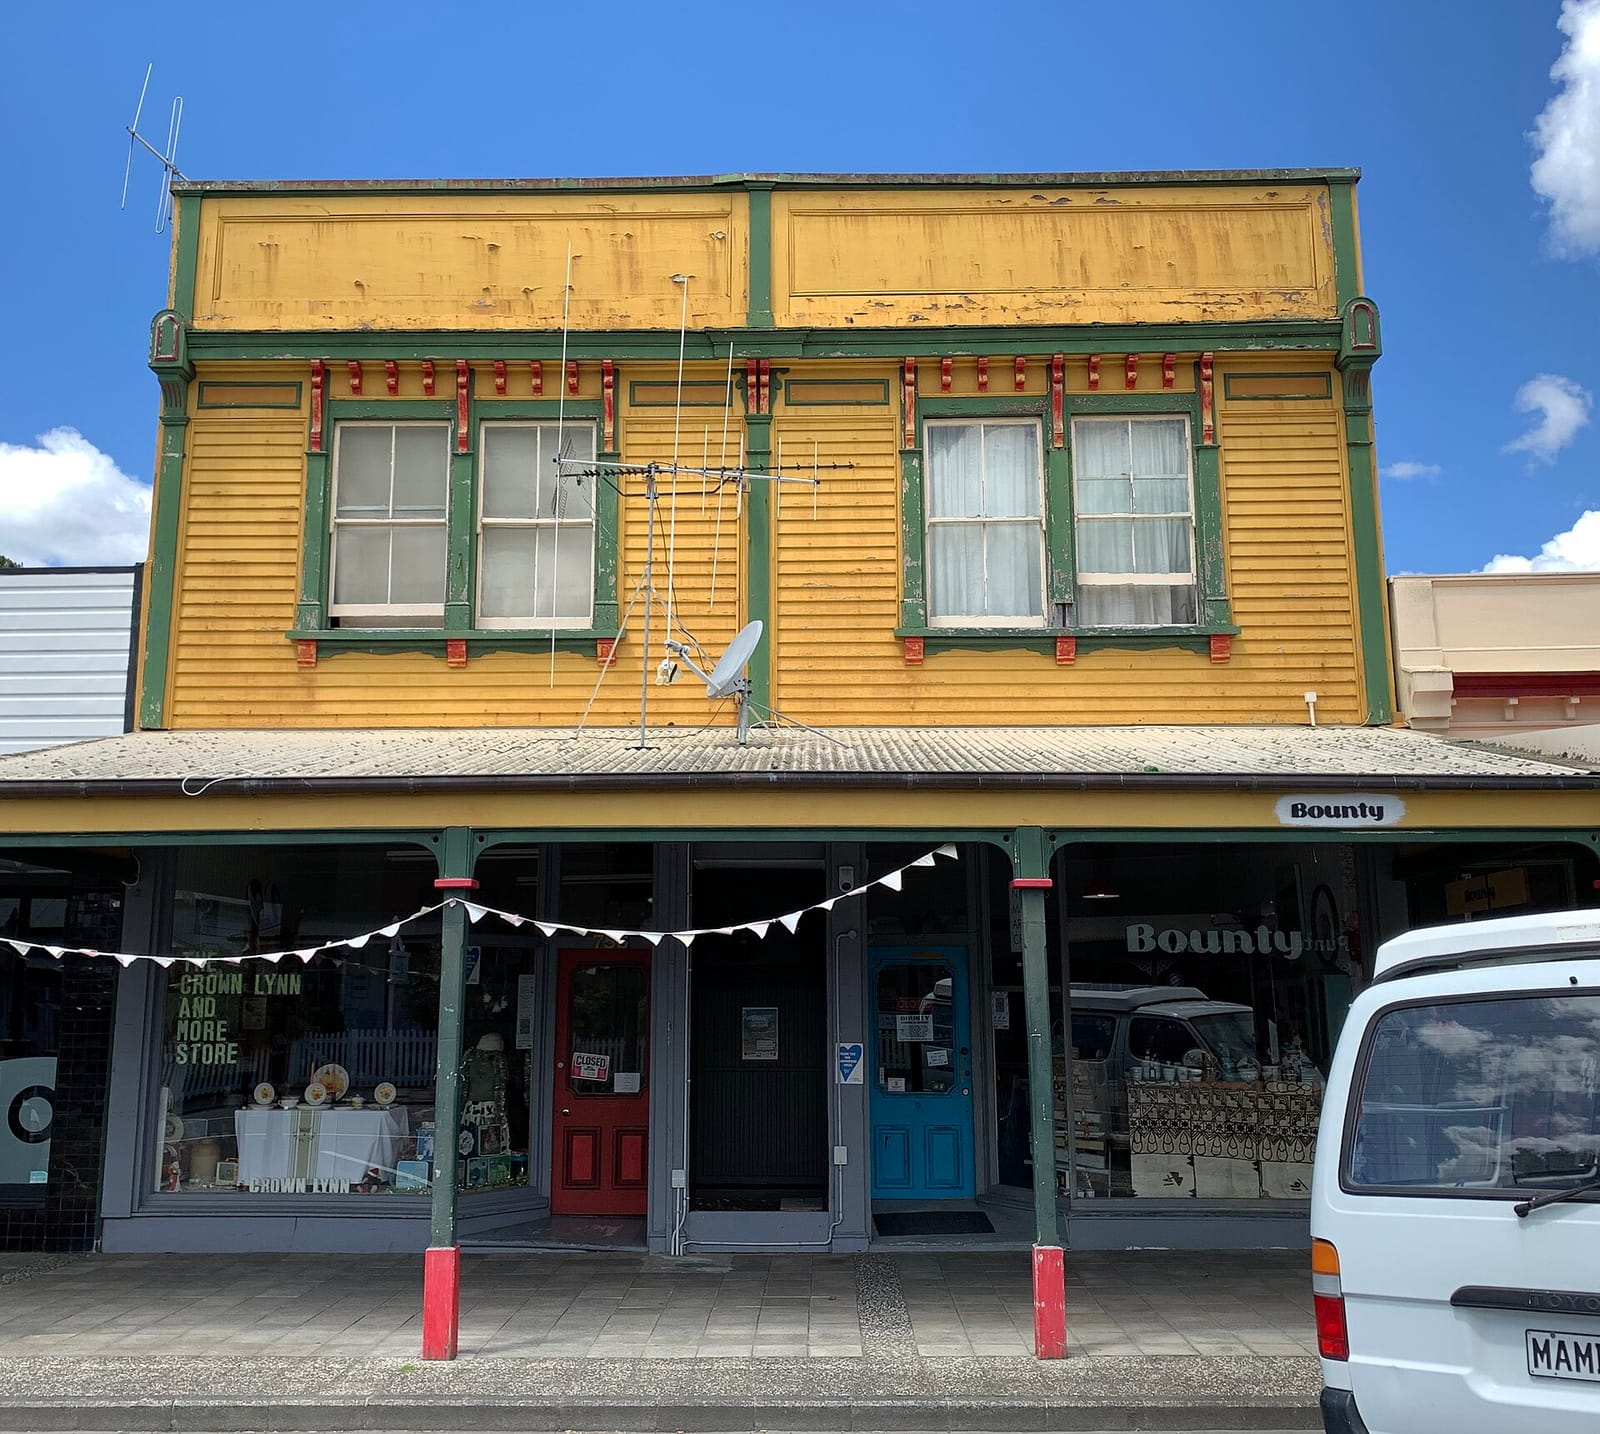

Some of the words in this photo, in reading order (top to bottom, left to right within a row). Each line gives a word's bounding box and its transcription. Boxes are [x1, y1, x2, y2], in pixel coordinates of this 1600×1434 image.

[1291, 803, 1384, 821] Bounty
[1126, 923, 1302, 960] Bounty
[180, 973, 243, 995] CROWN
[254, 973, 301, 995] LYNN
[178, 996, 217, 1018] AND
[176, 1019, 228, 1041] MORE
[176, 1042, 239, 1064] STORE
[576, 1055, 606, 1068] CLOSED
[249, 1178, 306, 1193] CROWN
[313, 1178, 350, 1193] LYNN
[1532, 1337, 1600, 1374] MAM
